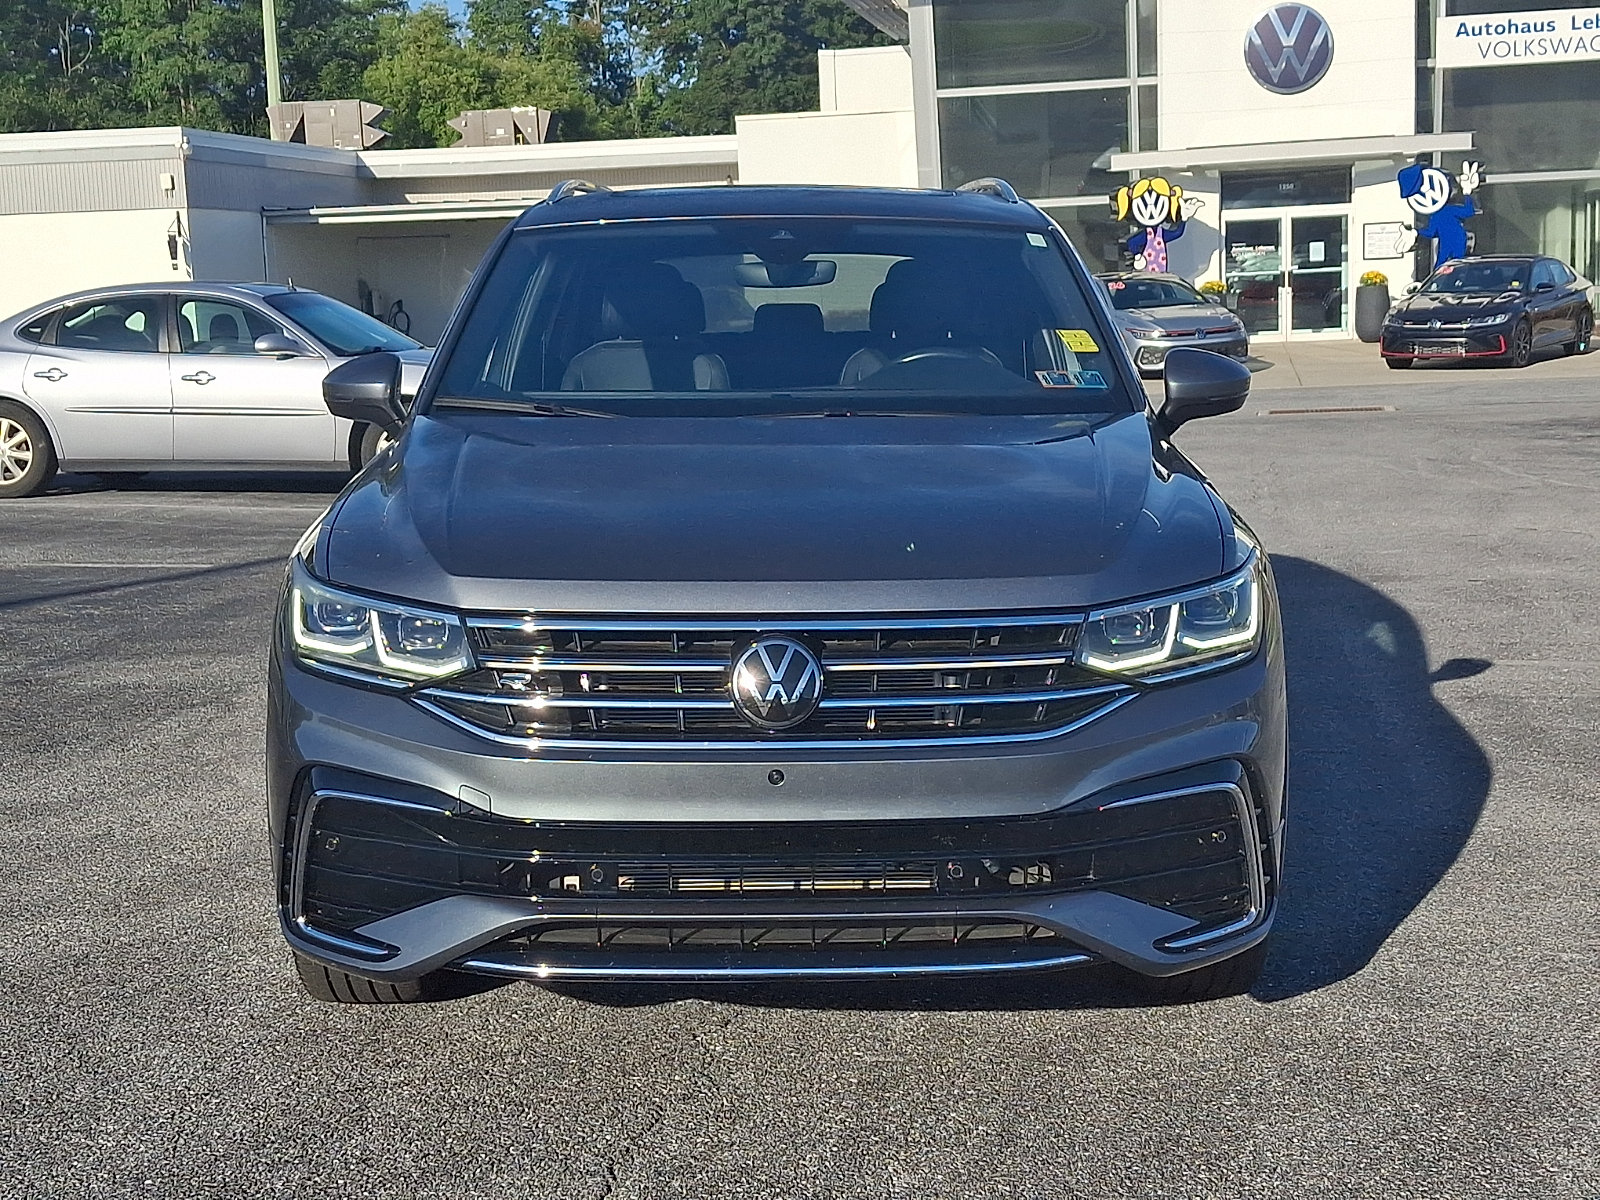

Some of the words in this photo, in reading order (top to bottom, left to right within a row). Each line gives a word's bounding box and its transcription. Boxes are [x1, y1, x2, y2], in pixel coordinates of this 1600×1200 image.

[1248, 6, 1329, 84] VW
[1455, 18, 1556, 38] Autohaus
[738, 643, 817, 717] VW
